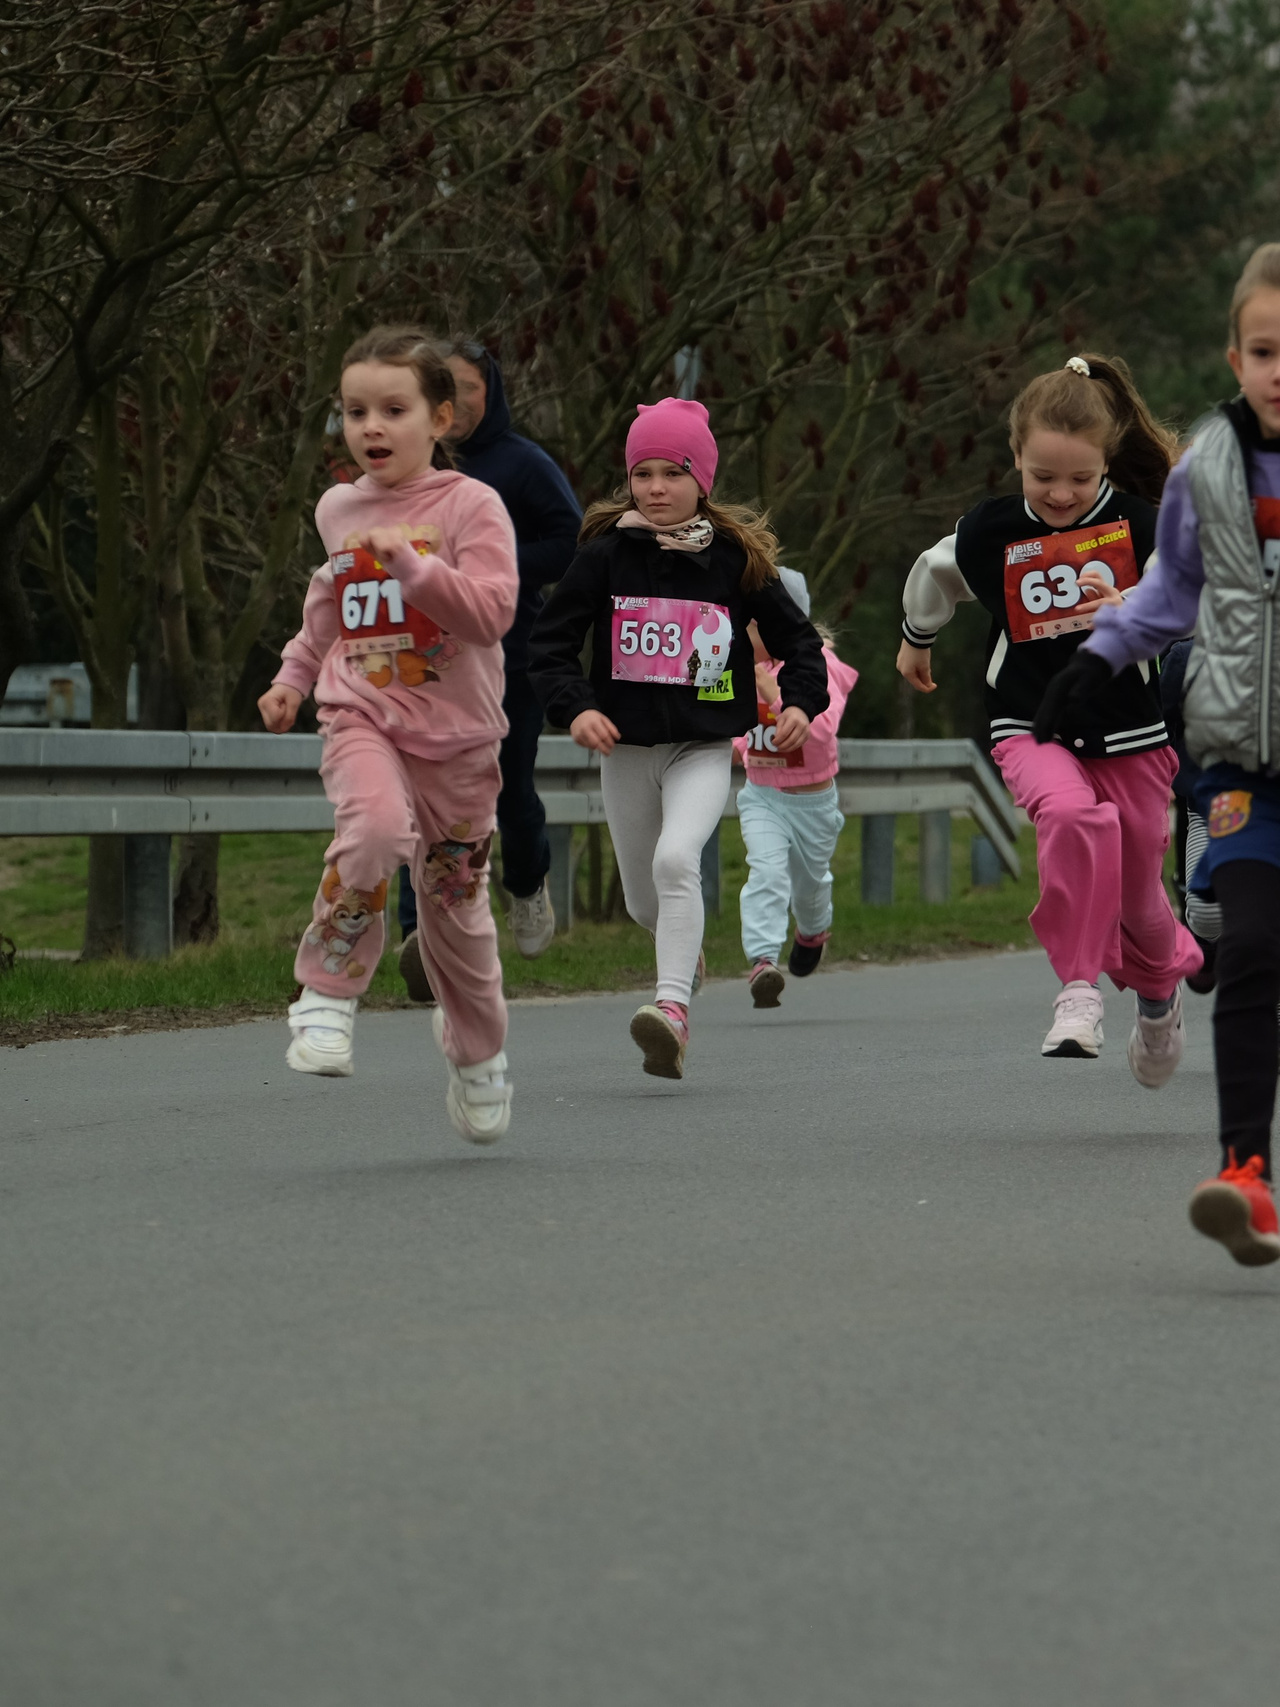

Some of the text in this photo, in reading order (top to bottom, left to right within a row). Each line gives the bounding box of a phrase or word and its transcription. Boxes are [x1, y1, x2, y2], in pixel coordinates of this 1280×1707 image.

[1016, 541, 1042, 553] BIEG
[1075, 529, 1127, 553] BIEG DZIECI
[341, 578, 405, 630] 671
[619, 620, 682, 657] 563
[643, 674, 687, 684] 998m MDP
